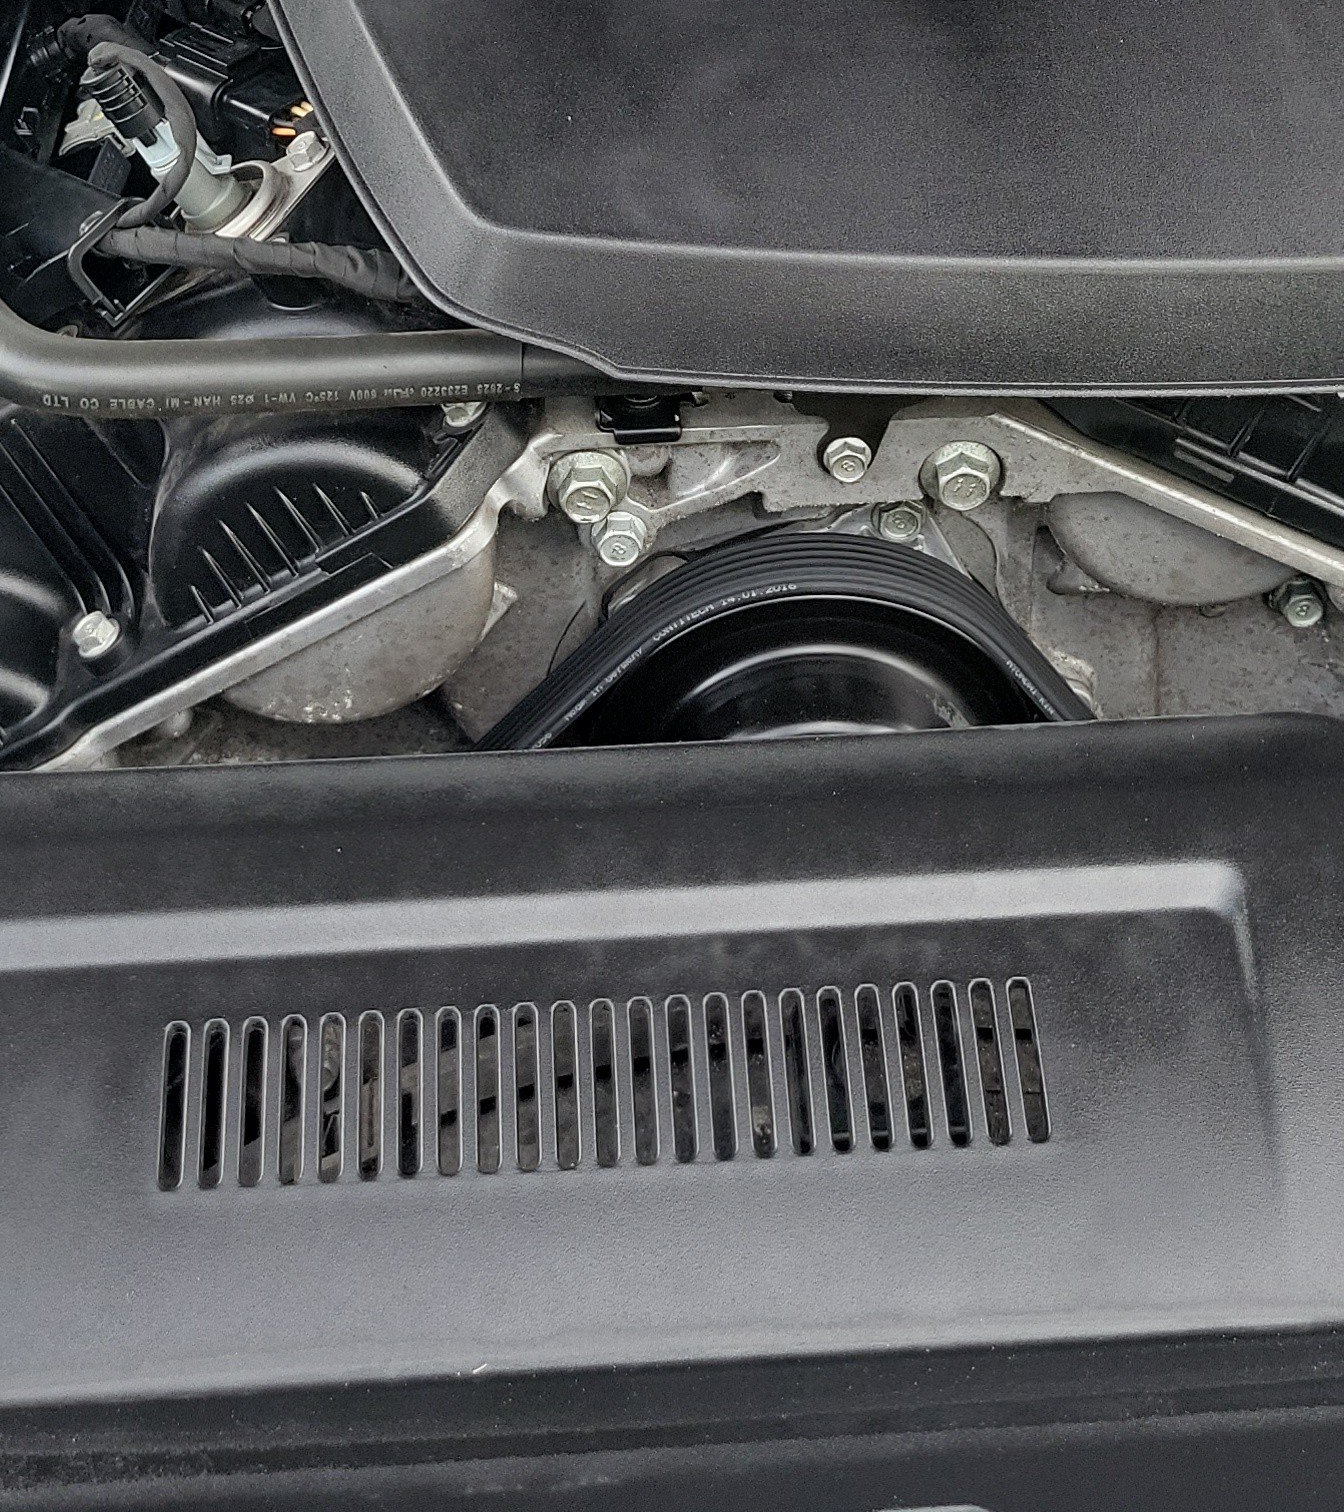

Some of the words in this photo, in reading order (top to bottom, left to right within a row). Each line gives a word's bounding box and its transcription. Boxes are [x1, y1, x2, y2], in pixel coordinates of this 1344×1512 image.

[42, 393, 69, 409] LTD
[80, 398, 99, 410] CO
[263, 392, 296, 404] VW-1
[109, 398, 155, 411] CABLE
